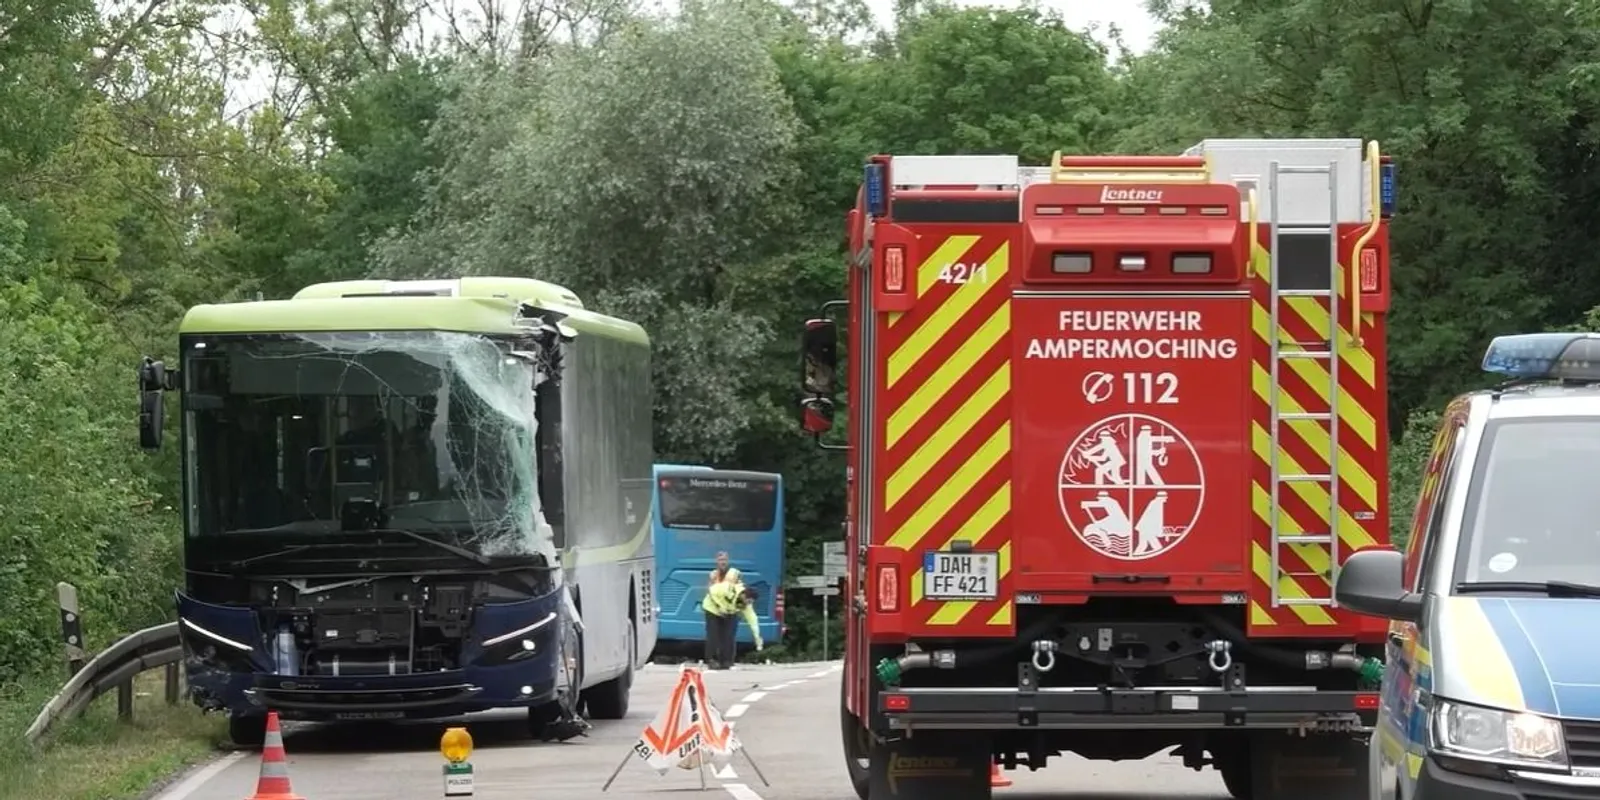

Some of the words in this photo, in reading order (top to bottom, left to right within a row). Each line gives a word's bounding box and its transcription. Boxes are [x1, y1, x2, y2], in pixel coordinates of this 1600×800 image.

[938, 262, 987, 284] 42/1
[1059, 311, 1203, 331] FEUERWEHR
[1025, 338, 1238, 359] AMPERMOCHING
[1123, 372, 1179, 404] 112
[690, 479, 747, 489] Mercedes-Benz
[941, 556, 971, 573] DAH
[933, 576, 954, 593] FF
[958, 576, 987, 593] 421
